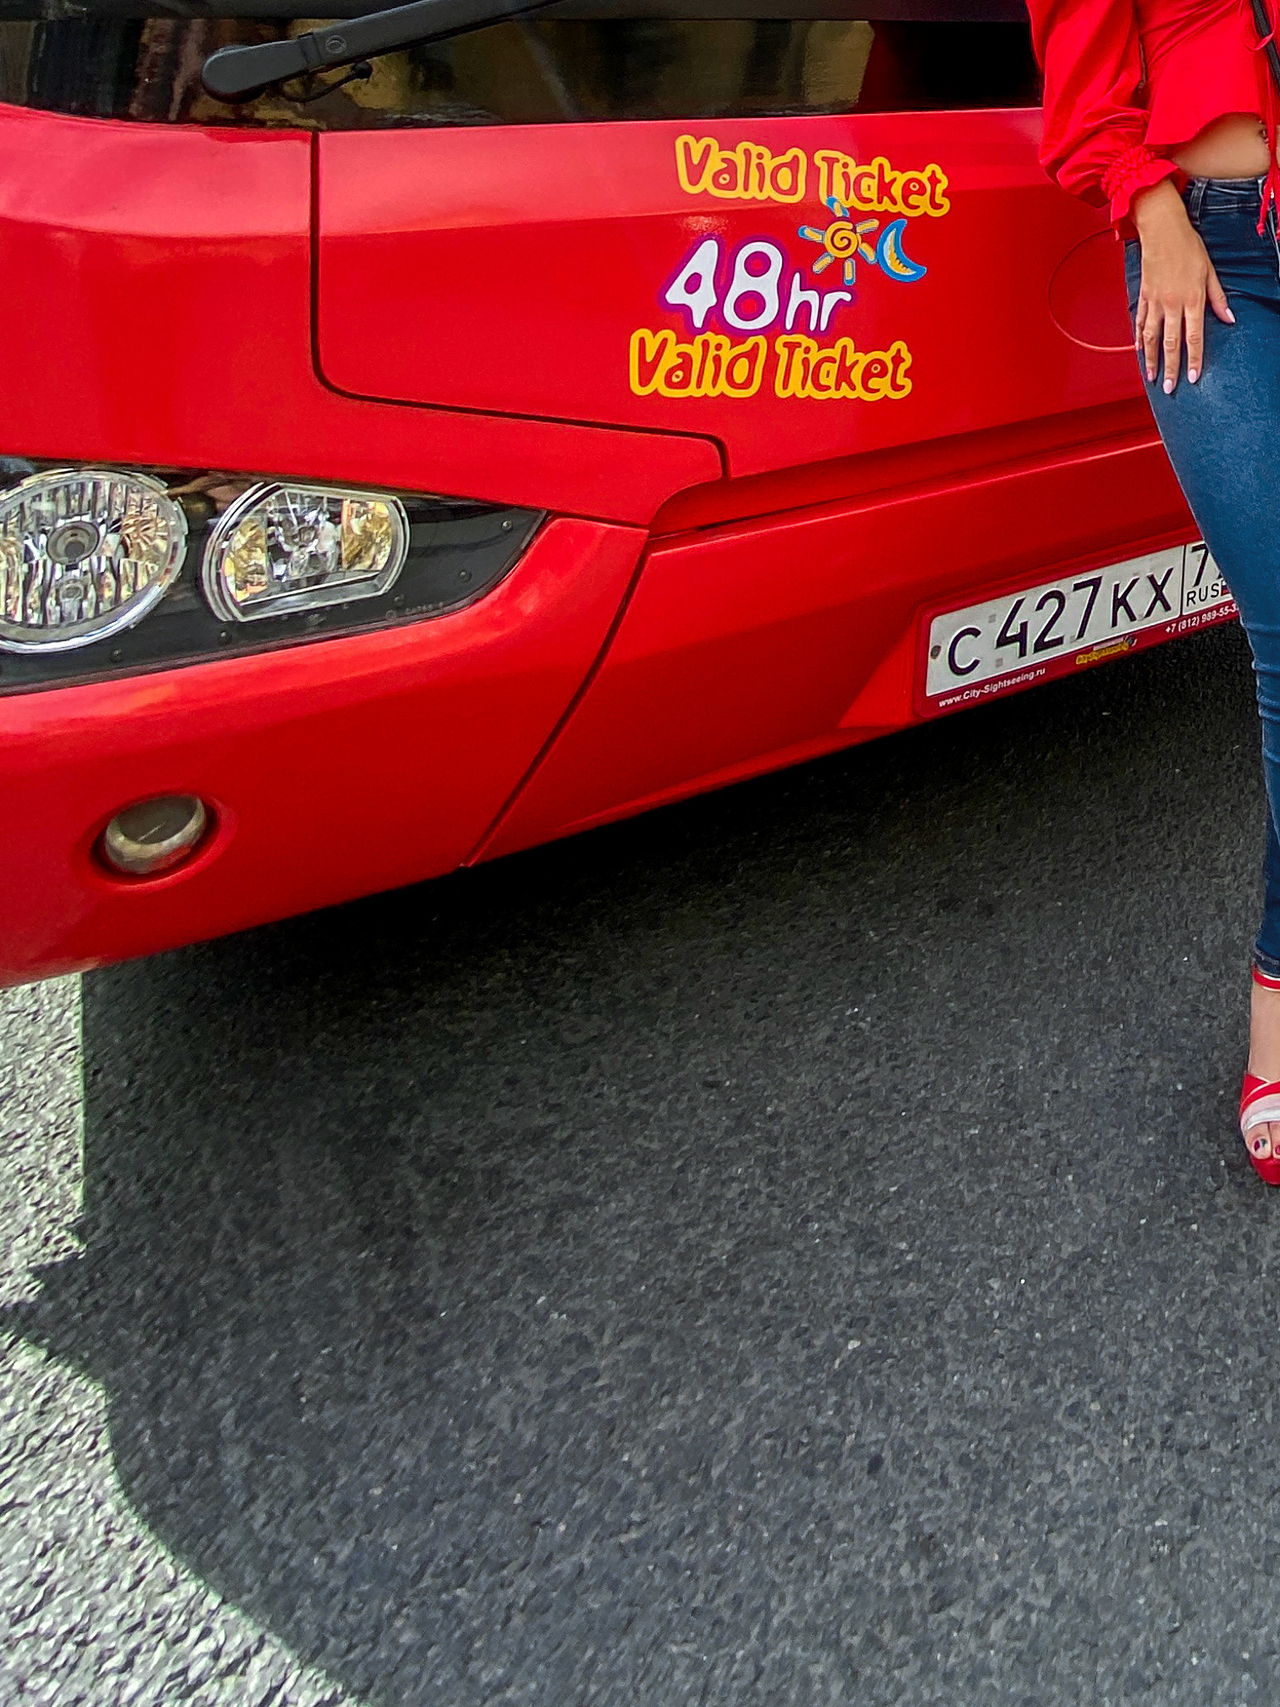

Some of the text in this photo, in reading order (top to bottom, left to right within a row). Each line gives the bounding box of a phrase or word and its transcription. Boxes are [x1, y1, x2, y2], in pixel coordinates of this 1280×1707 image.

[675, 135, 950, 217] Valid Ticket
[630, 328, 912, 401] Valid Ticket
[1190, 543, 1223, 587] 7
[1186, 583, 1219, 607] RUS
[1165, 623, 1177, 633] +7
[1178, 616, 1200, 632] (812)
